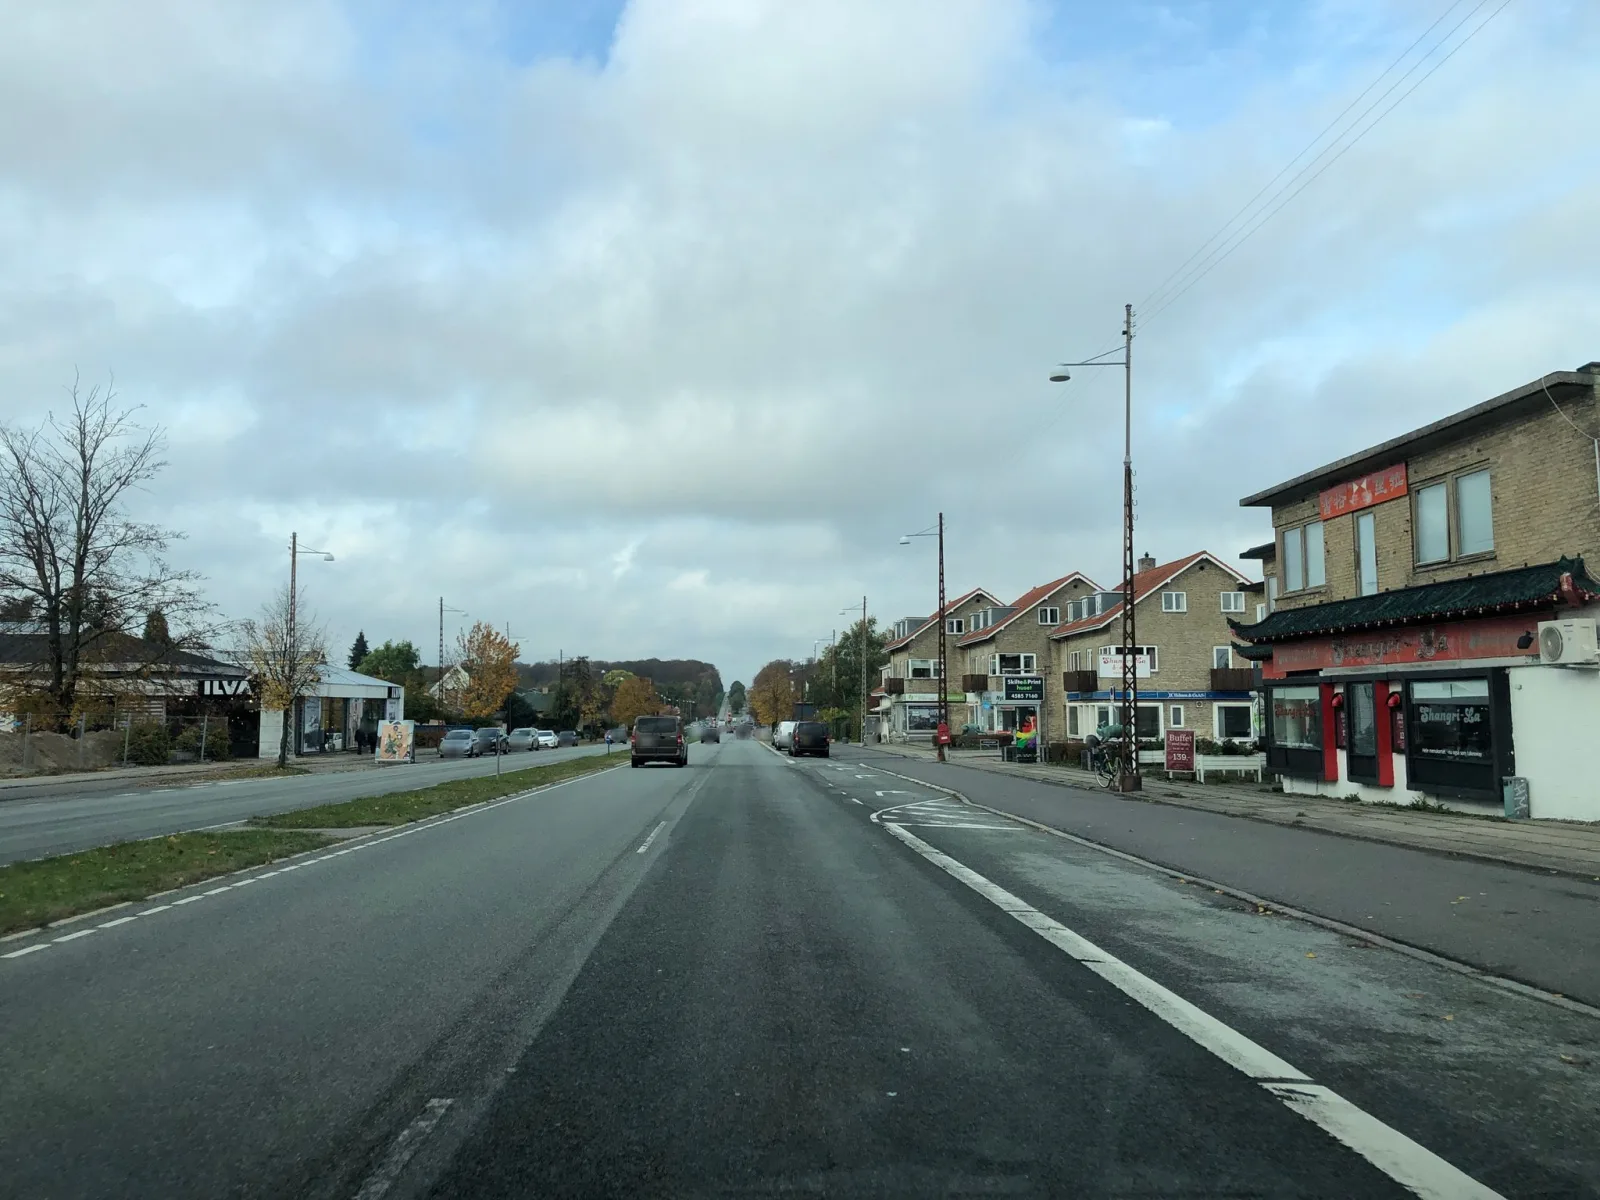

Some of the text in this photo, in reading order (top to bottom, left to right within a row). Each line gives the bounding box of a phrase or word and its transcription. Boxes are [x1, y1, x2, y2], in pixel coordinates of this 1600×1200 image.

[204, 680, 252, 695] ILVA
[1419, 706, 1482, 725] Shangri-La
[1169, 734, 1192, 742] Buffet
[1173, 753, 1191, 761] 139,-
